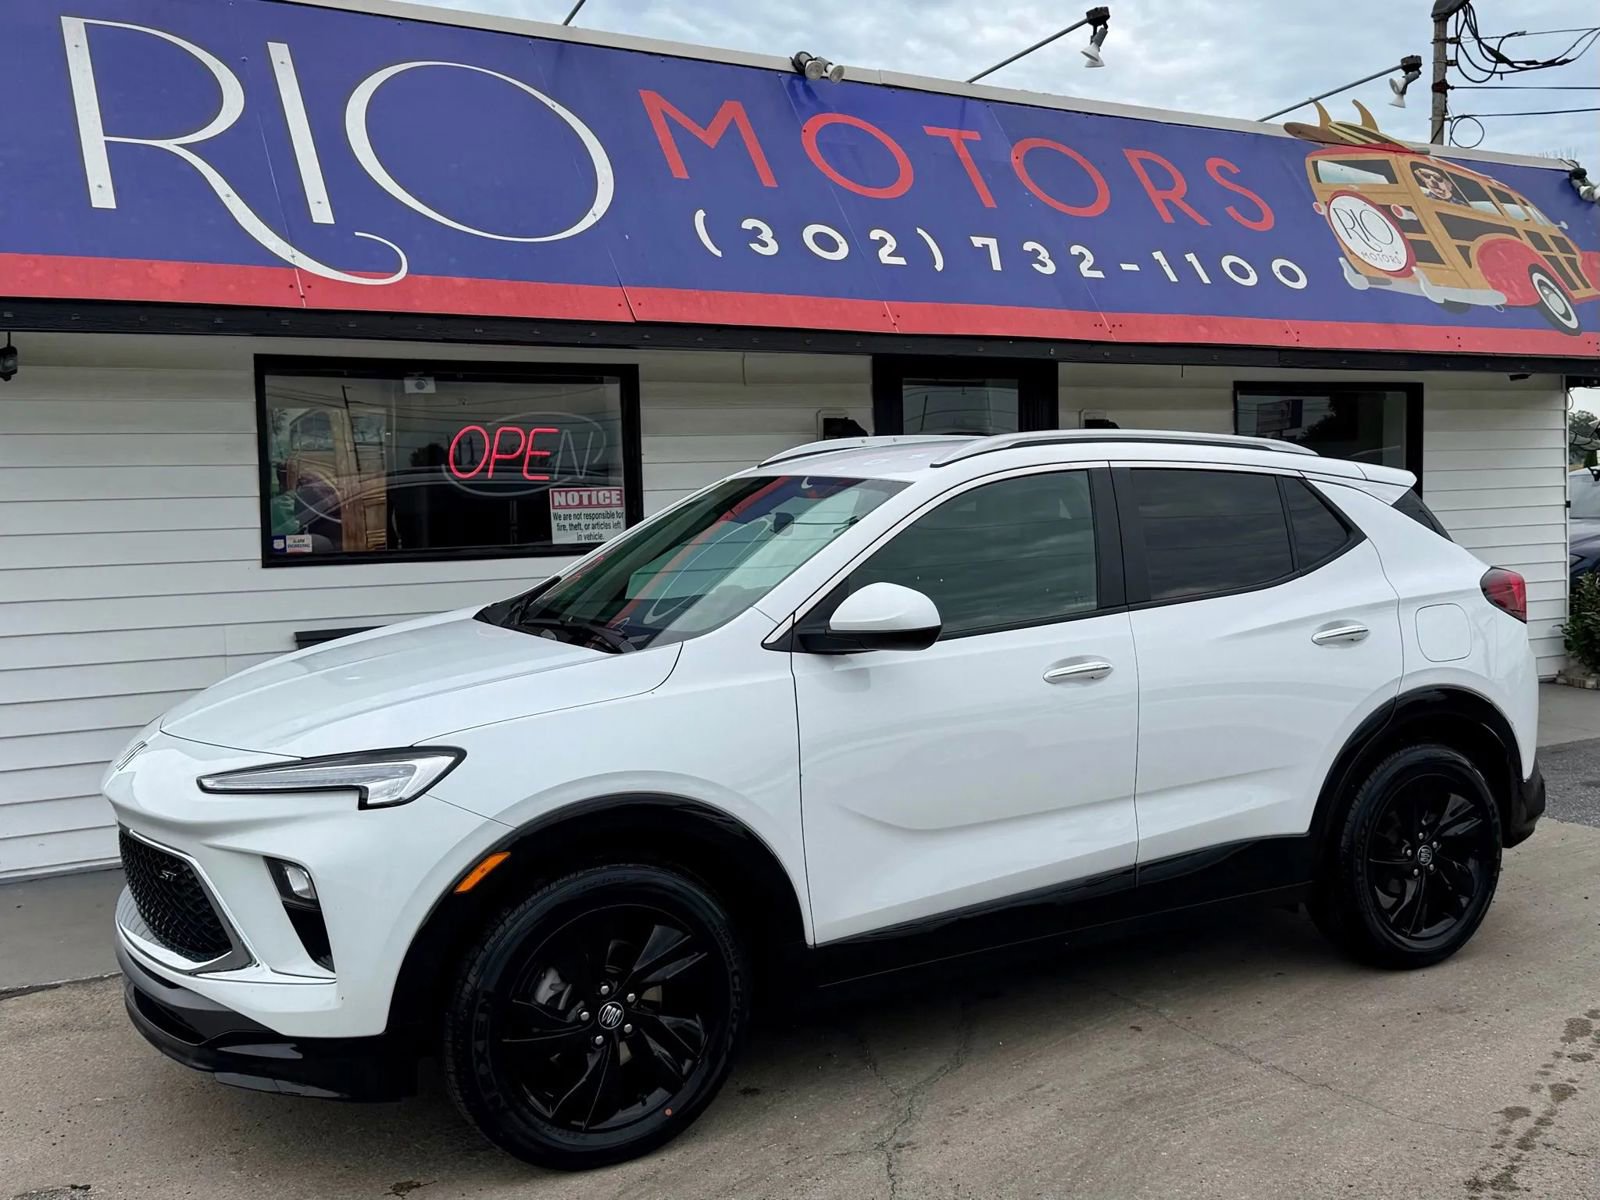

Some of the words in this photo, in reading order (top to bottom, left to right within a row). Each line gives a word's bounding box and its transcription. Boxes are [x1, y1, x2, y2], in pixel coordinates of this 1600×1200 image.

[61, 16, 614, 285] RIO
[638, 89, 1275, 232] MOTORS
[1332, 207, 1394, 253] RIO
[694, 209, 945, 272] (302)
[969, 235, 1308, 290] 732-1100
[1360, 250, 1402, 265] MOTORS
[448, 425, 594, 480] OPEN
[552, 490, 622, 506] NOTICE
[552, 512, 562, 521] We
[563, 513, 572, 521] are
[573, 512, 582, 521] not
[583, 511, 615, 521] responsible
[616, 510, 624, 519] for
[556, 522, 568, 532] fire,
[569, 522, 583, 532] theft,
[584, 523, 591, 531] or
[592, 521, 611, 531] articles
[612, 520, 622, 529] left
[584, 531, 605, 541] vehicle.
[159, 869, 177, 882] ST
